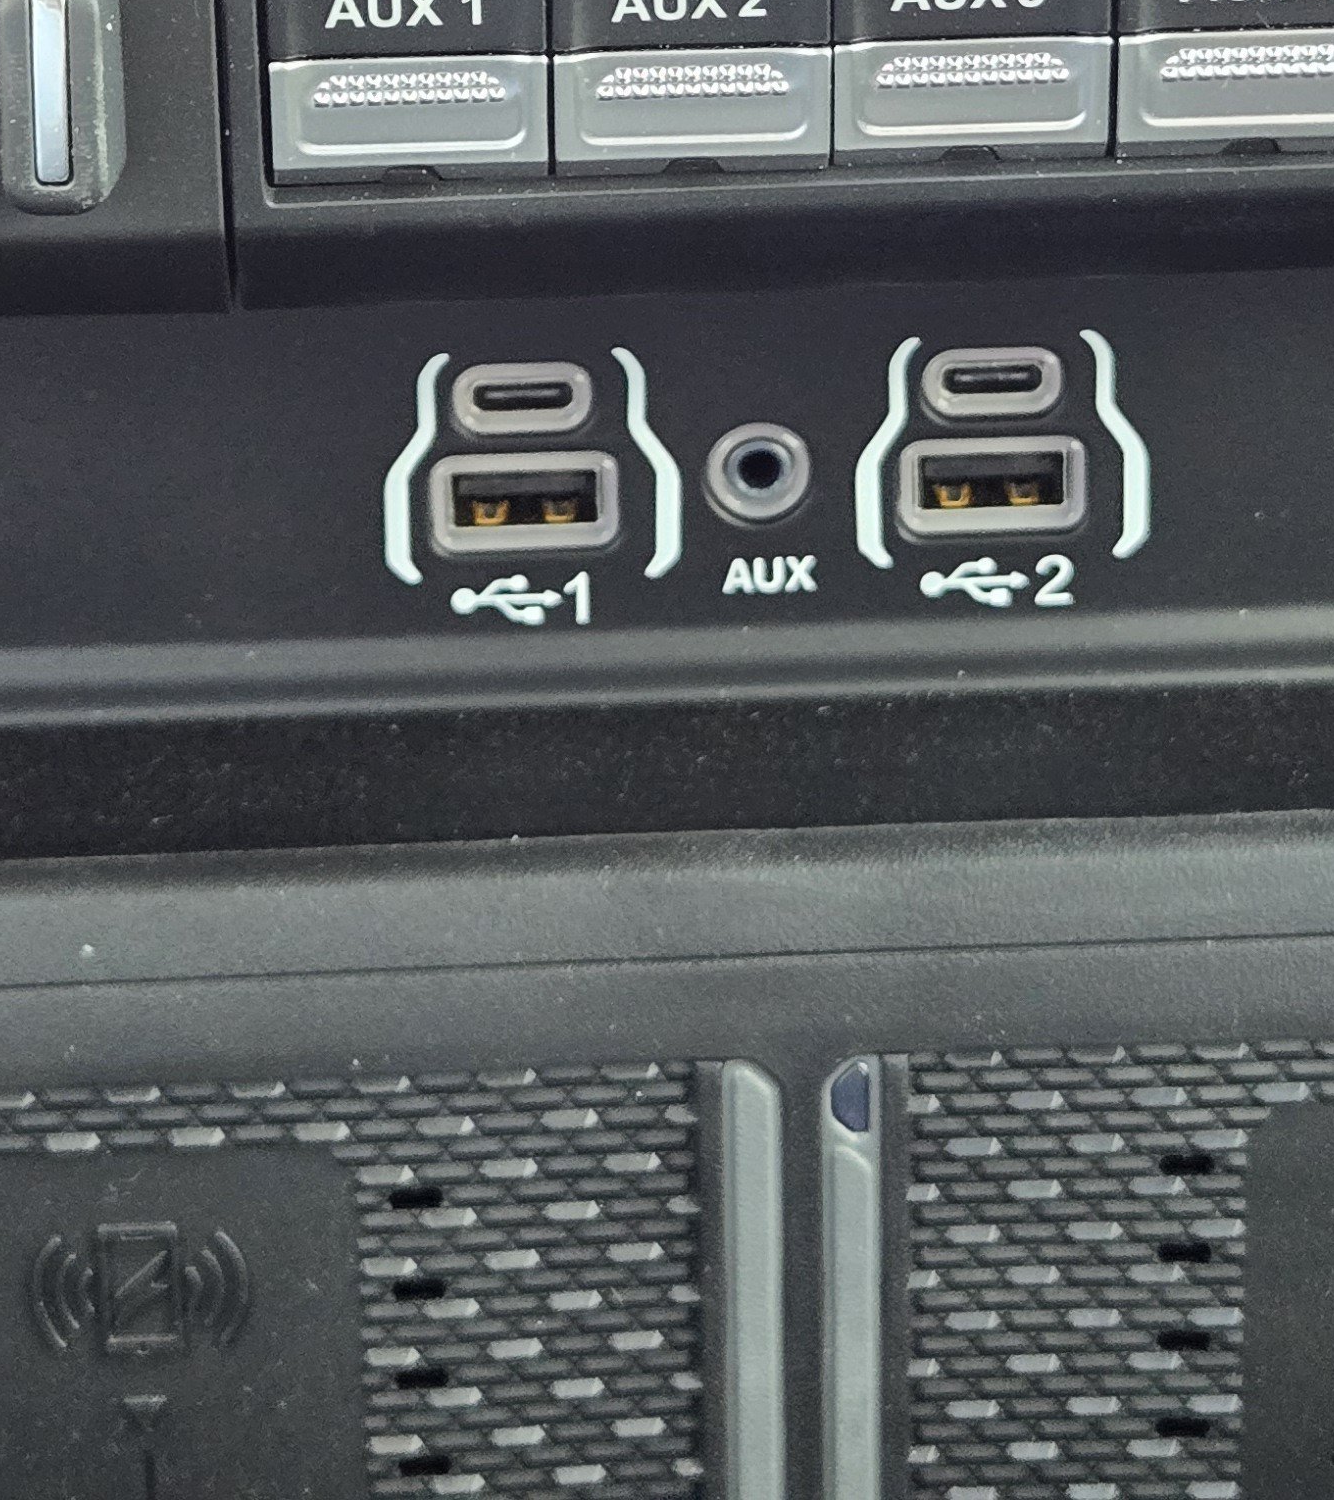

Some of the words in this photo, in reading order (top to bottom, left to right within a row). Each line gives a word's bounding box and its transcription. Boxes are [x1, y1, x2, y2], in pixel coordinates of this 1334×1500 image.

[563, 571, 591, 625] 1
[721, 554, 817, 595] AUX
[1034, 554, 1074, 606] 2
